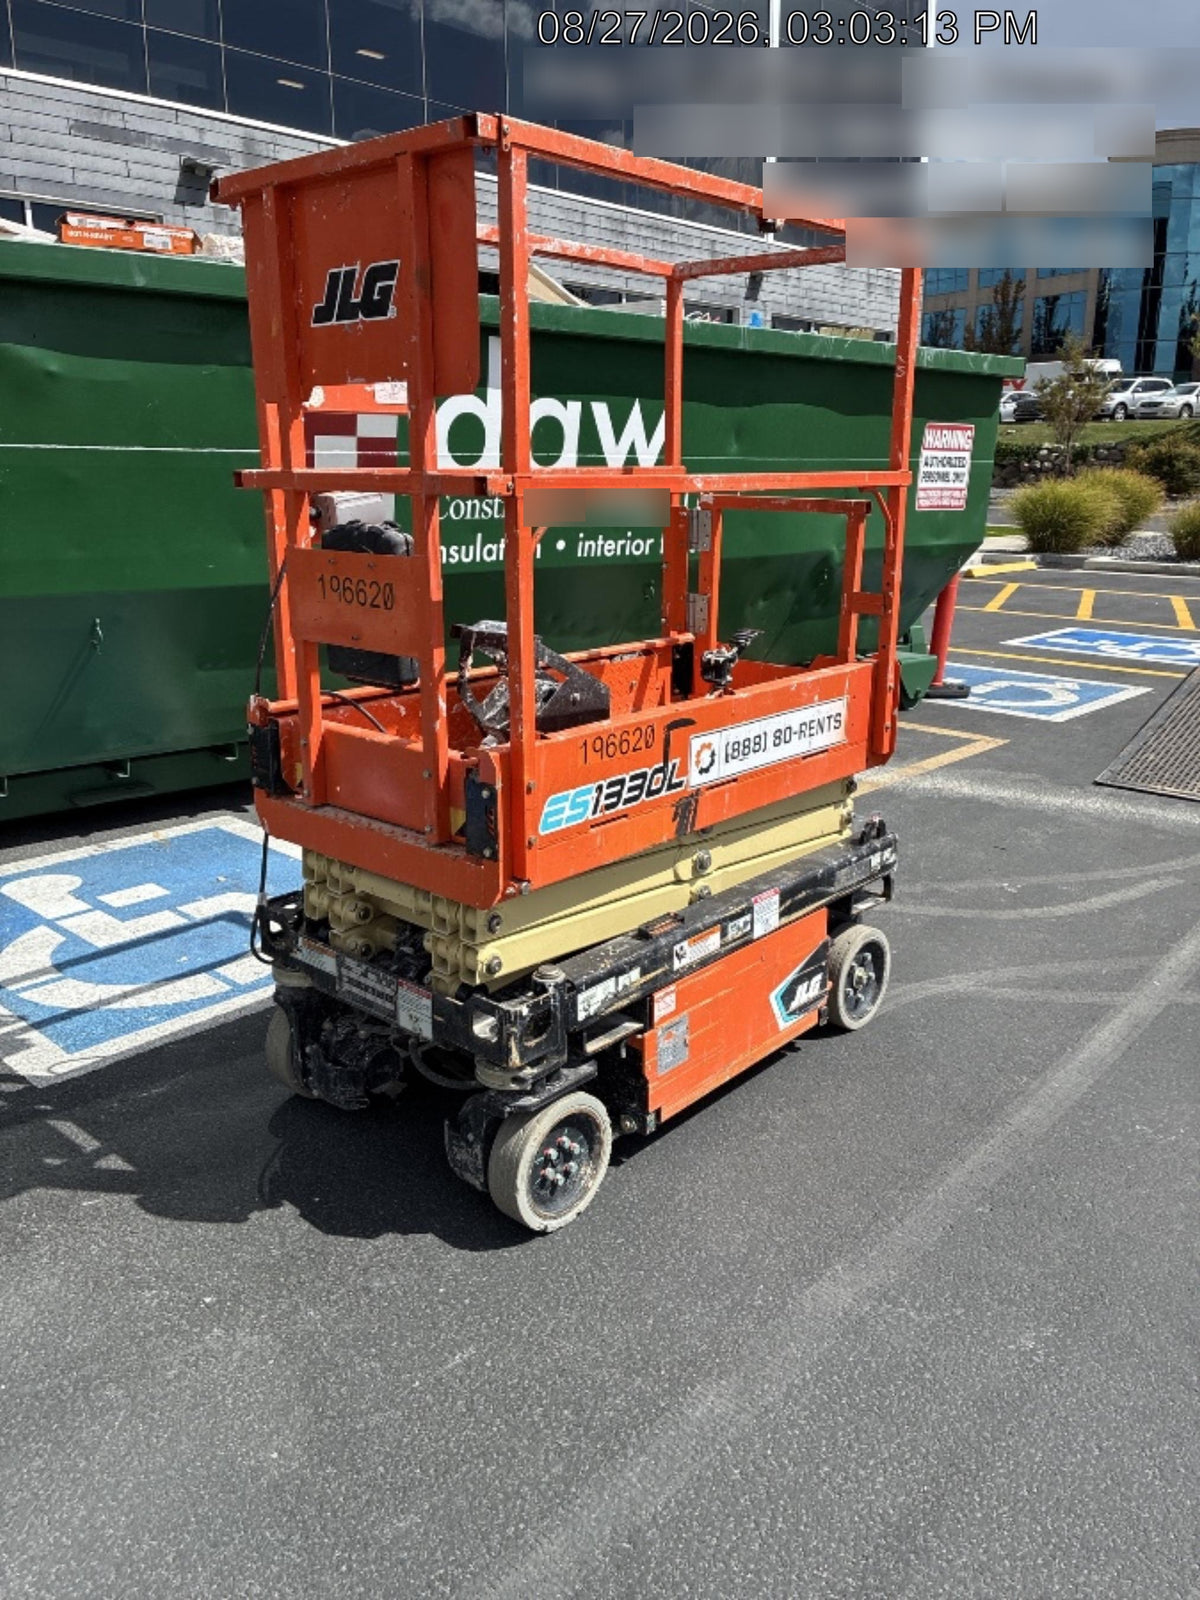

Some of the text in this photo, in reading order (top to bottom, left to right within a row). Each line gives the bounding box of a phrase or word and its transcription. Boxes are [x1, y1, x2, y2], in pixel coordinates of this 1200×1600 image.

[311, 259, 400, 327] JLG
[923, 429, 973, 450] WARNING
[577, 531, 654, 557] interior
[318, 573, 395, 610] 196620
[580, 723, 656, 765] 196620
[773, 712, 842, 748] 80-RENTS
